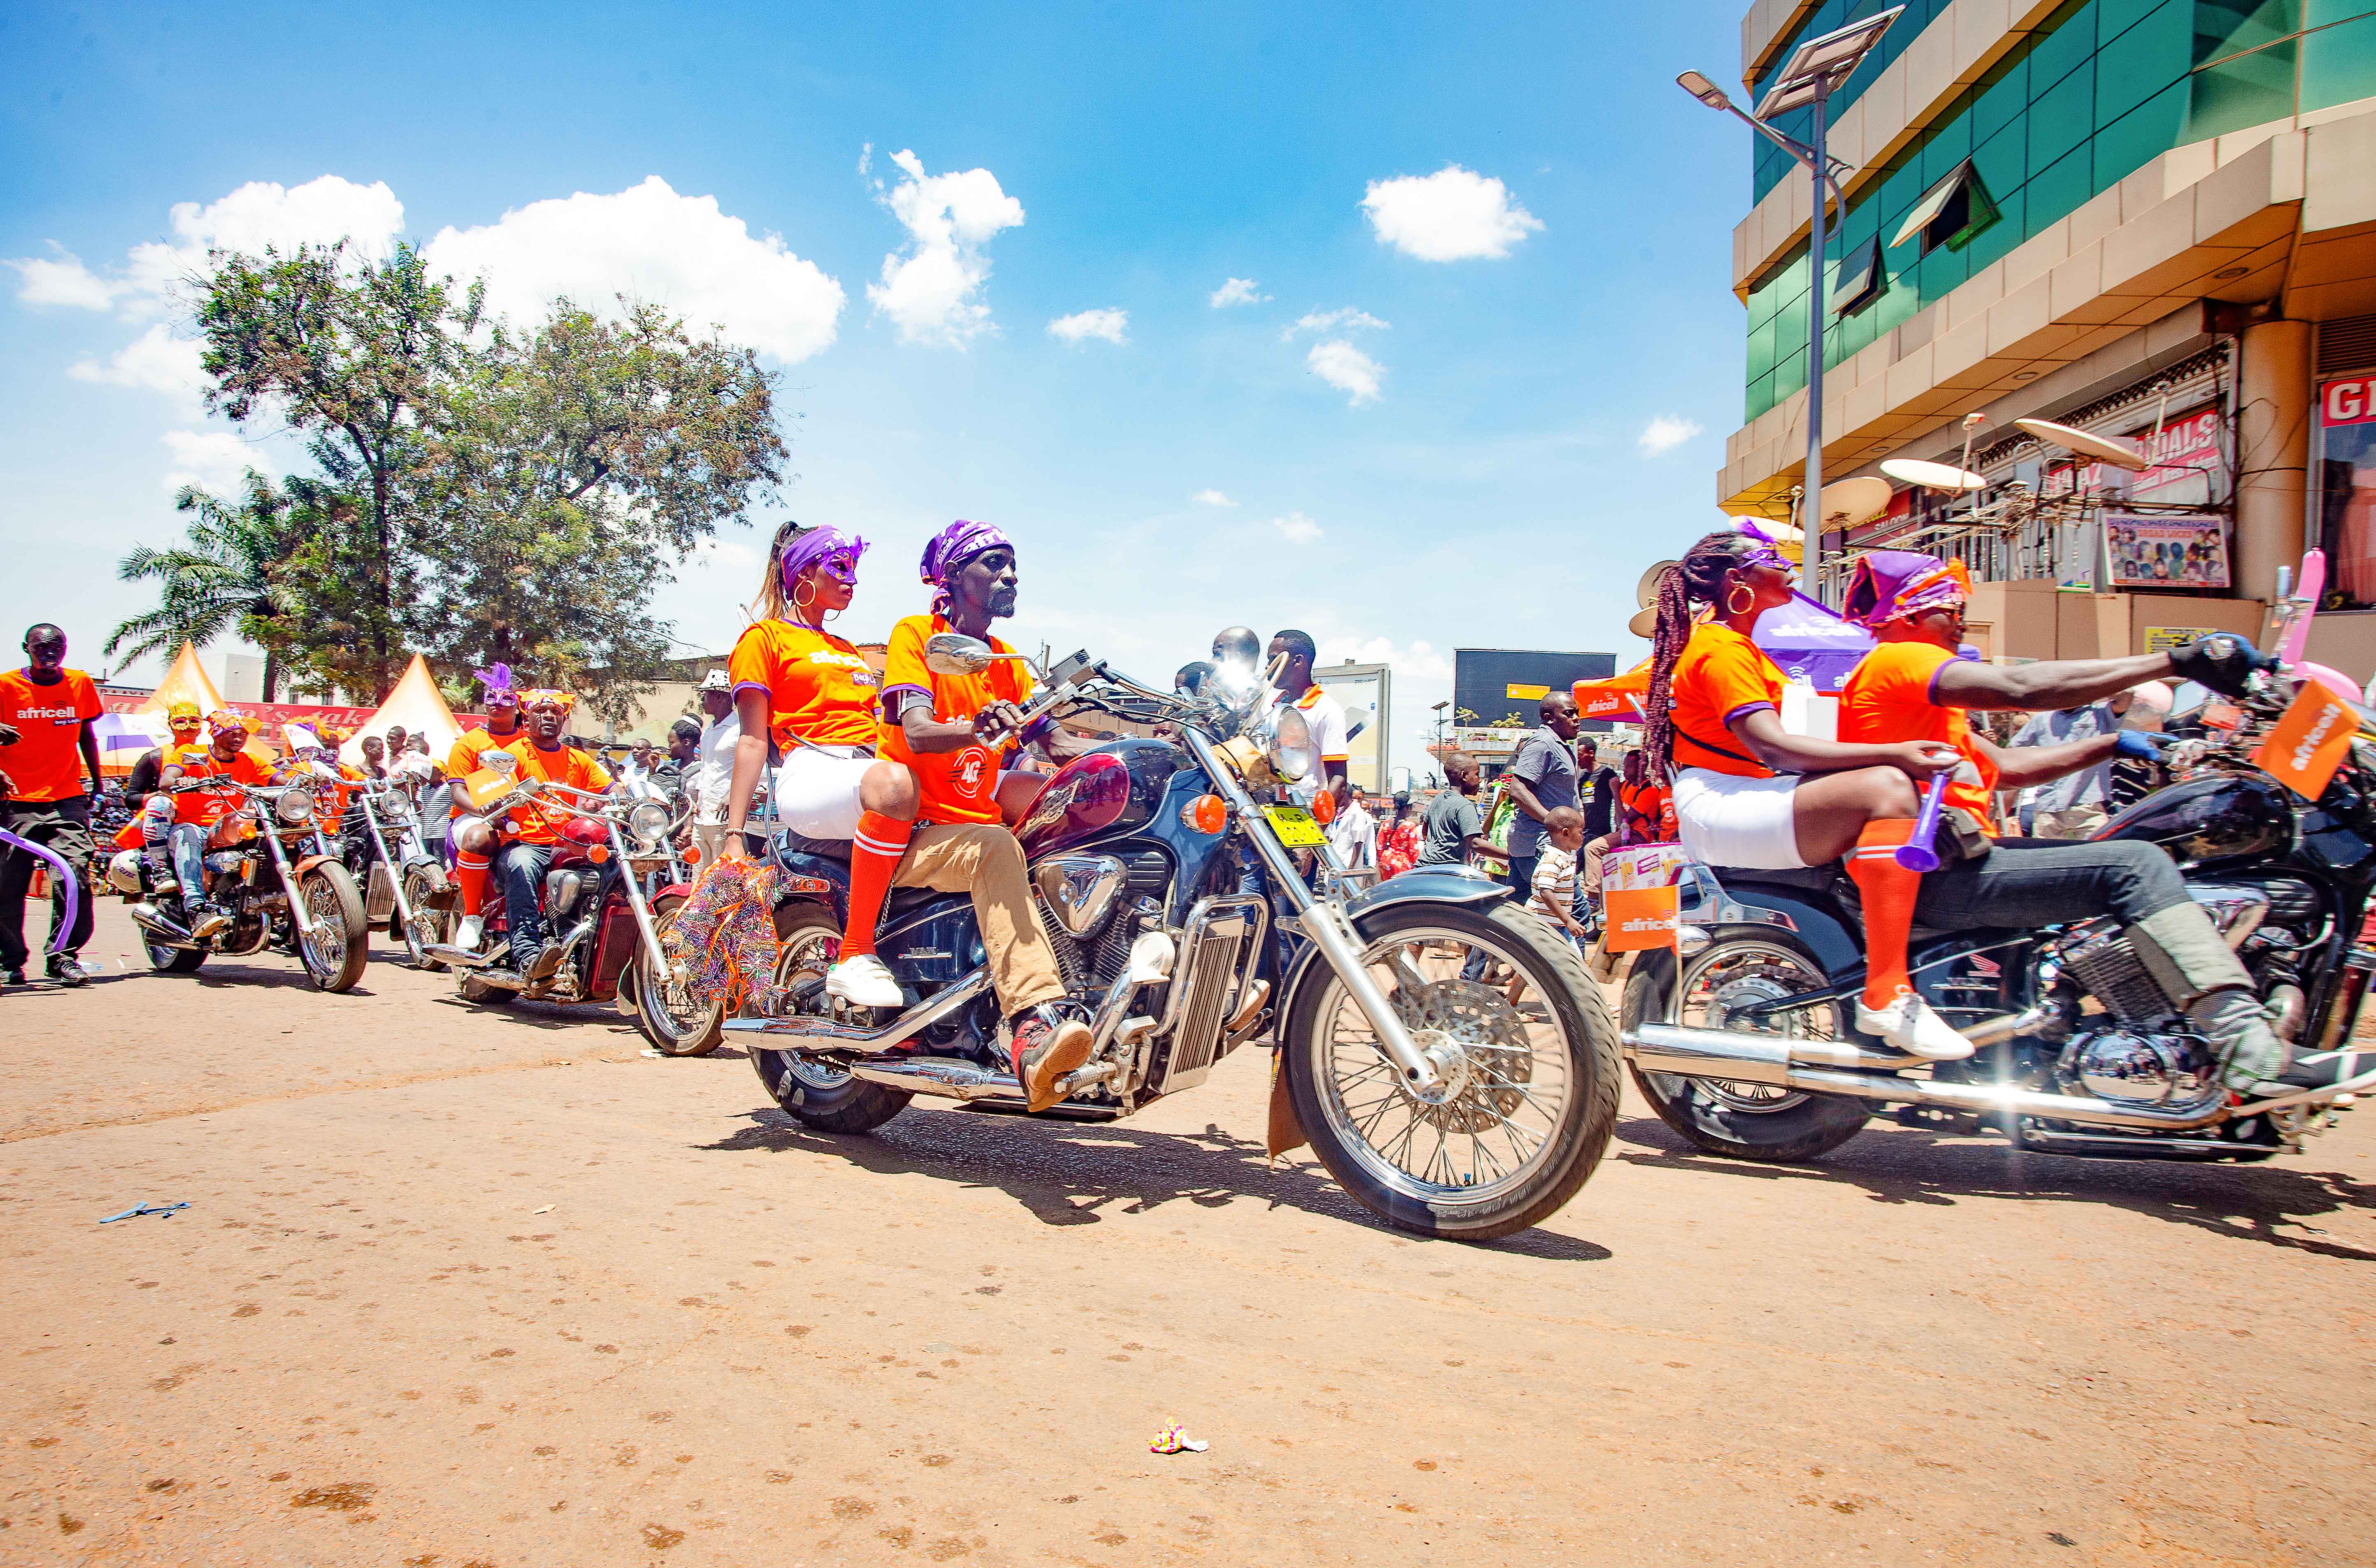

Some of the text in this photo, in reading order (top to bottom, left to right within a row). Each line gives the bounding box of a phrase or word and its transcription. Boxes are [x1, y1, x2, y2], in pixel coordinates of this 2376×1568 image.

[16, 706, 75, 719] africell
[1587, 697, 1619, 713] africell
[313, 710, 369, 726] tak
[961, 760, 981, 784] 4G
